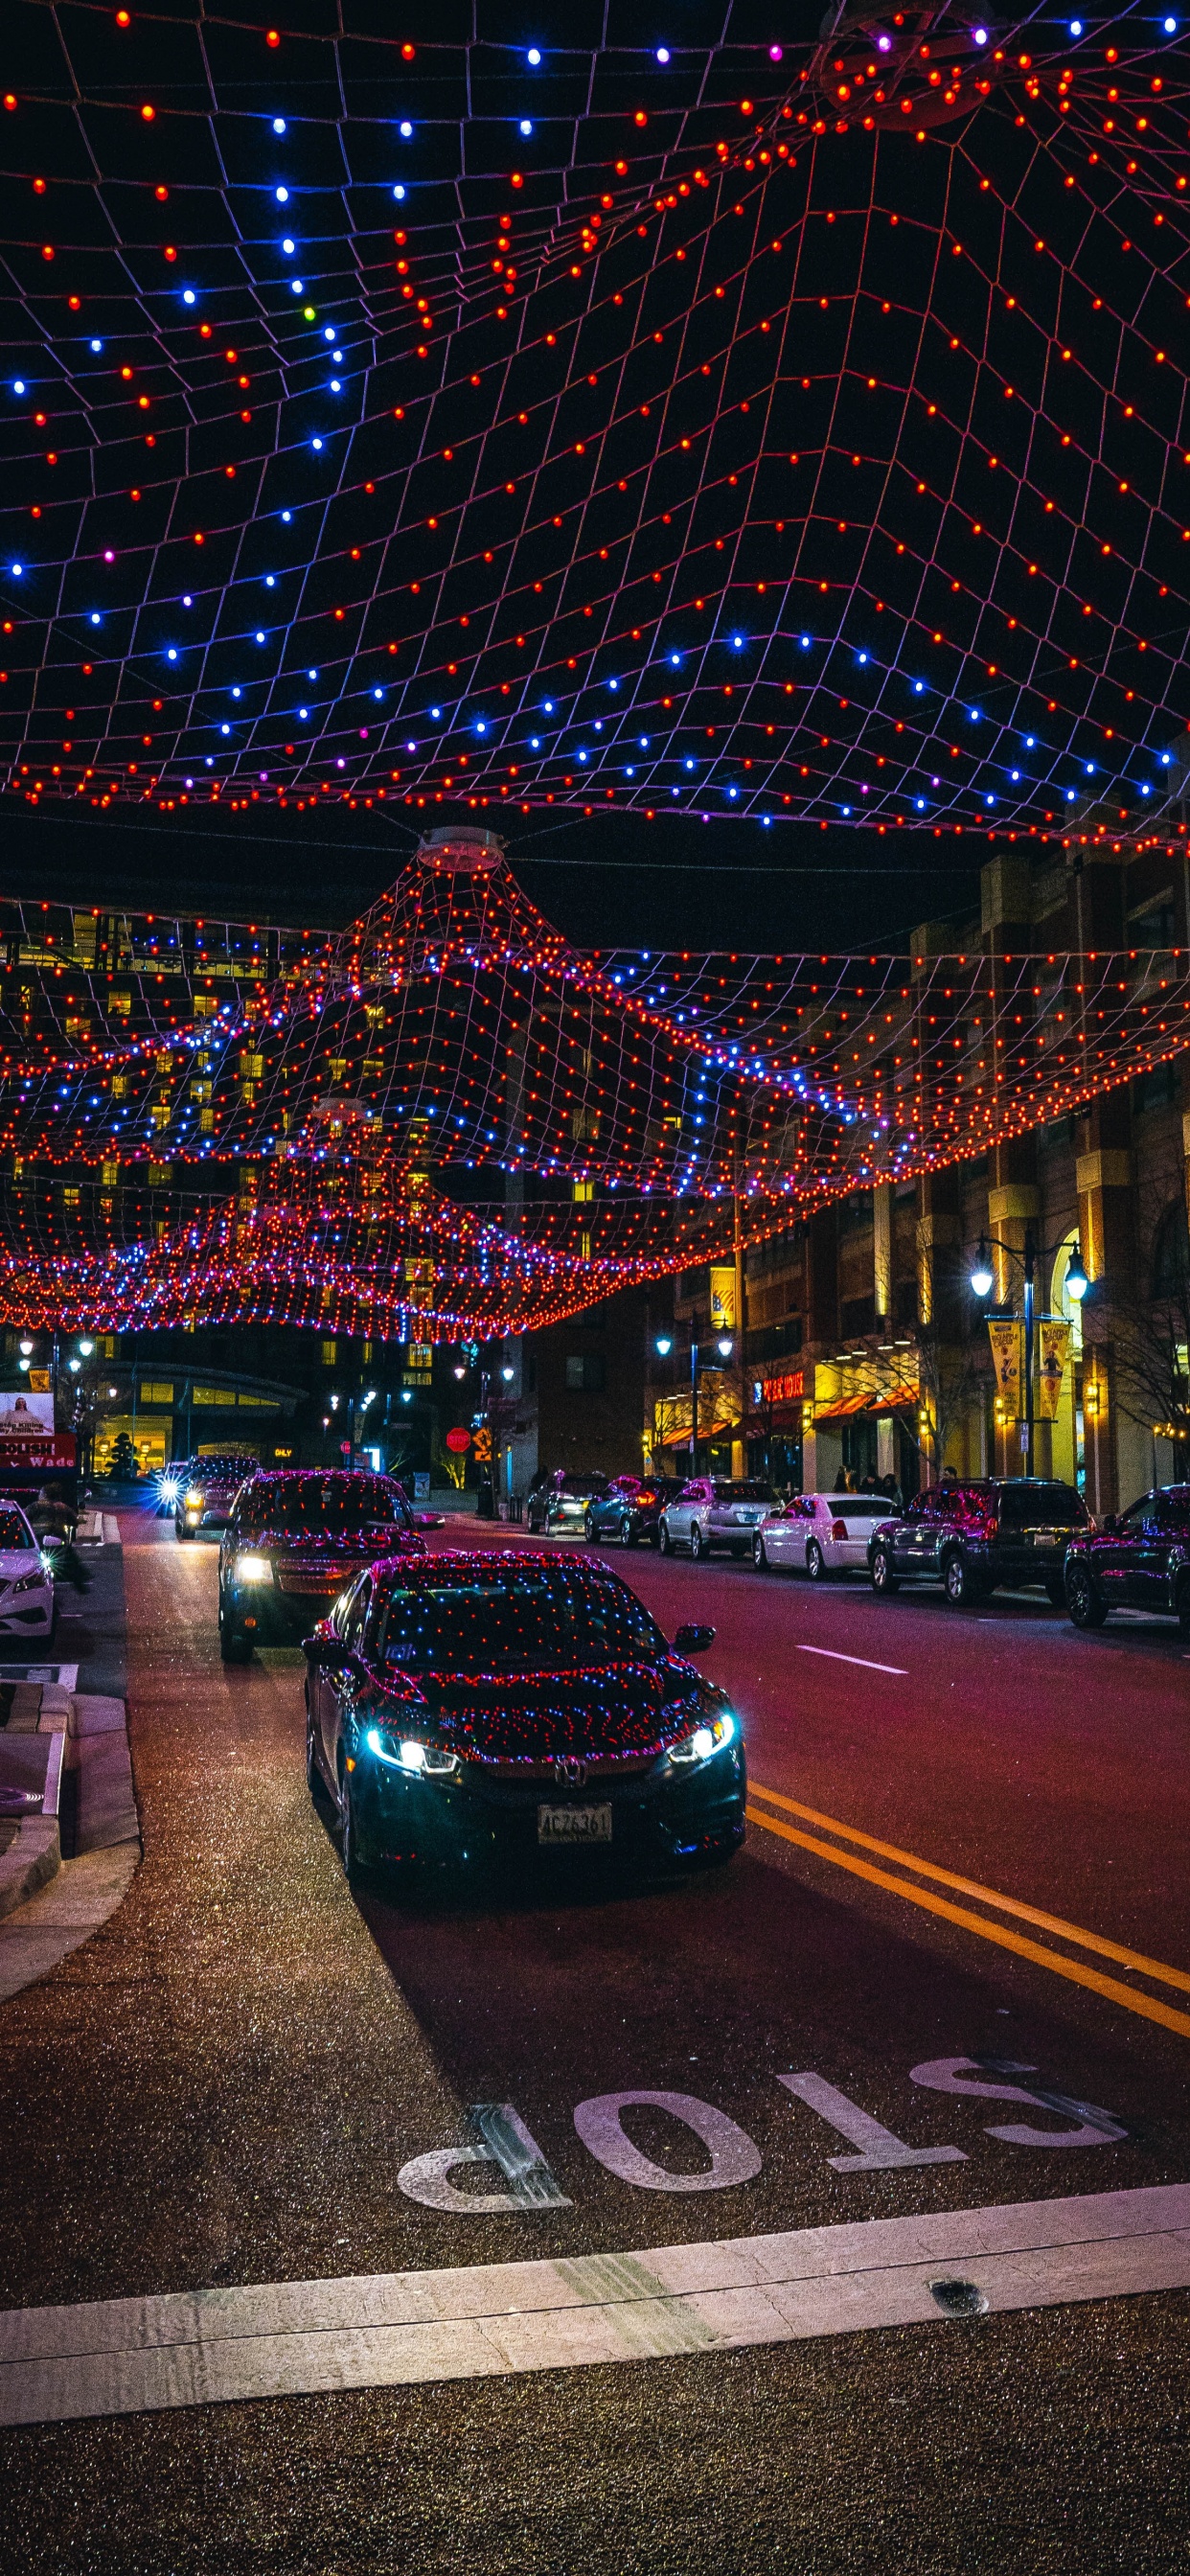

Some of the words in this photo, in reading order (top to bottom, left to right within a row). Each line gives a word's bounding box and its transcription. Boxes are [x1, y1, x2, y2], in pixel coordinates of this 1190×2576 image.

[784, 1370, 803, 1398] HOUSE
[30, 1457, 75, 1467] Wade
[275, 1448, 292, 1457] ONLY
[396, 2057, 1130, 2214] STOP
